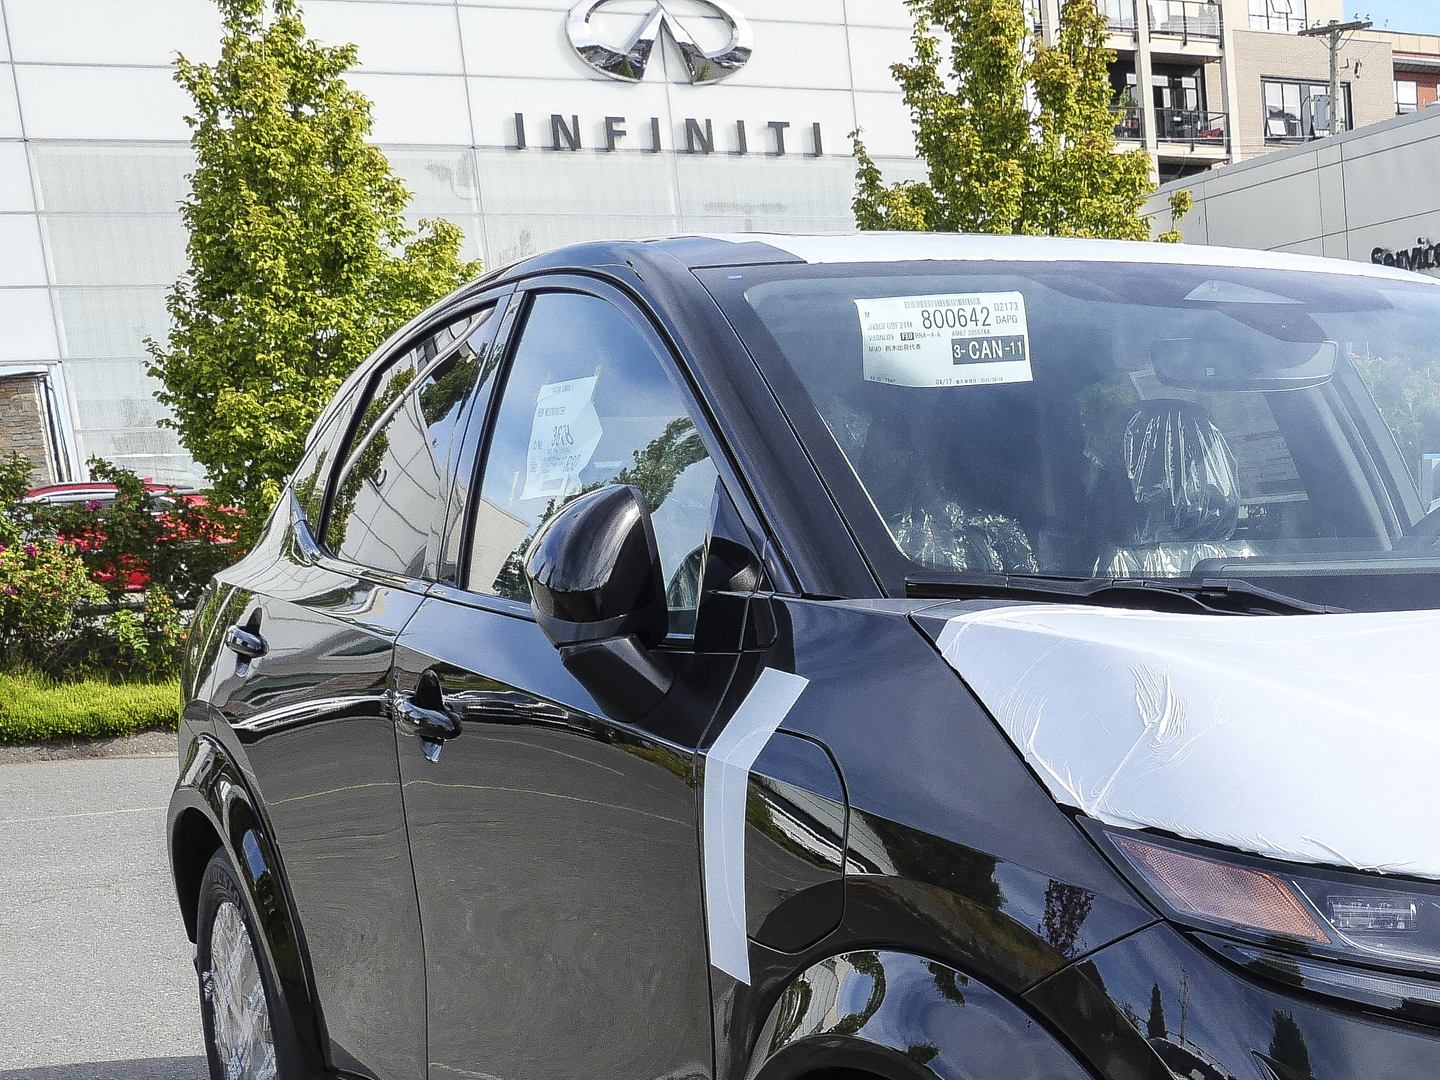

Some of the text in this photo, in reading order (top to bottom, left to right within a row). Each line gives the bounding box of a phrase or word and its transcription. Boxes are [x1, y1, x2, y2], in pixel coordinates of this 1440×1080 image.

[514, 112, 823, 155] INFINITI
[994, 302, 1018, 311] D2173
[922, 307, 991, 329] 800642
[995, 315, 1018, 324] DAPG
